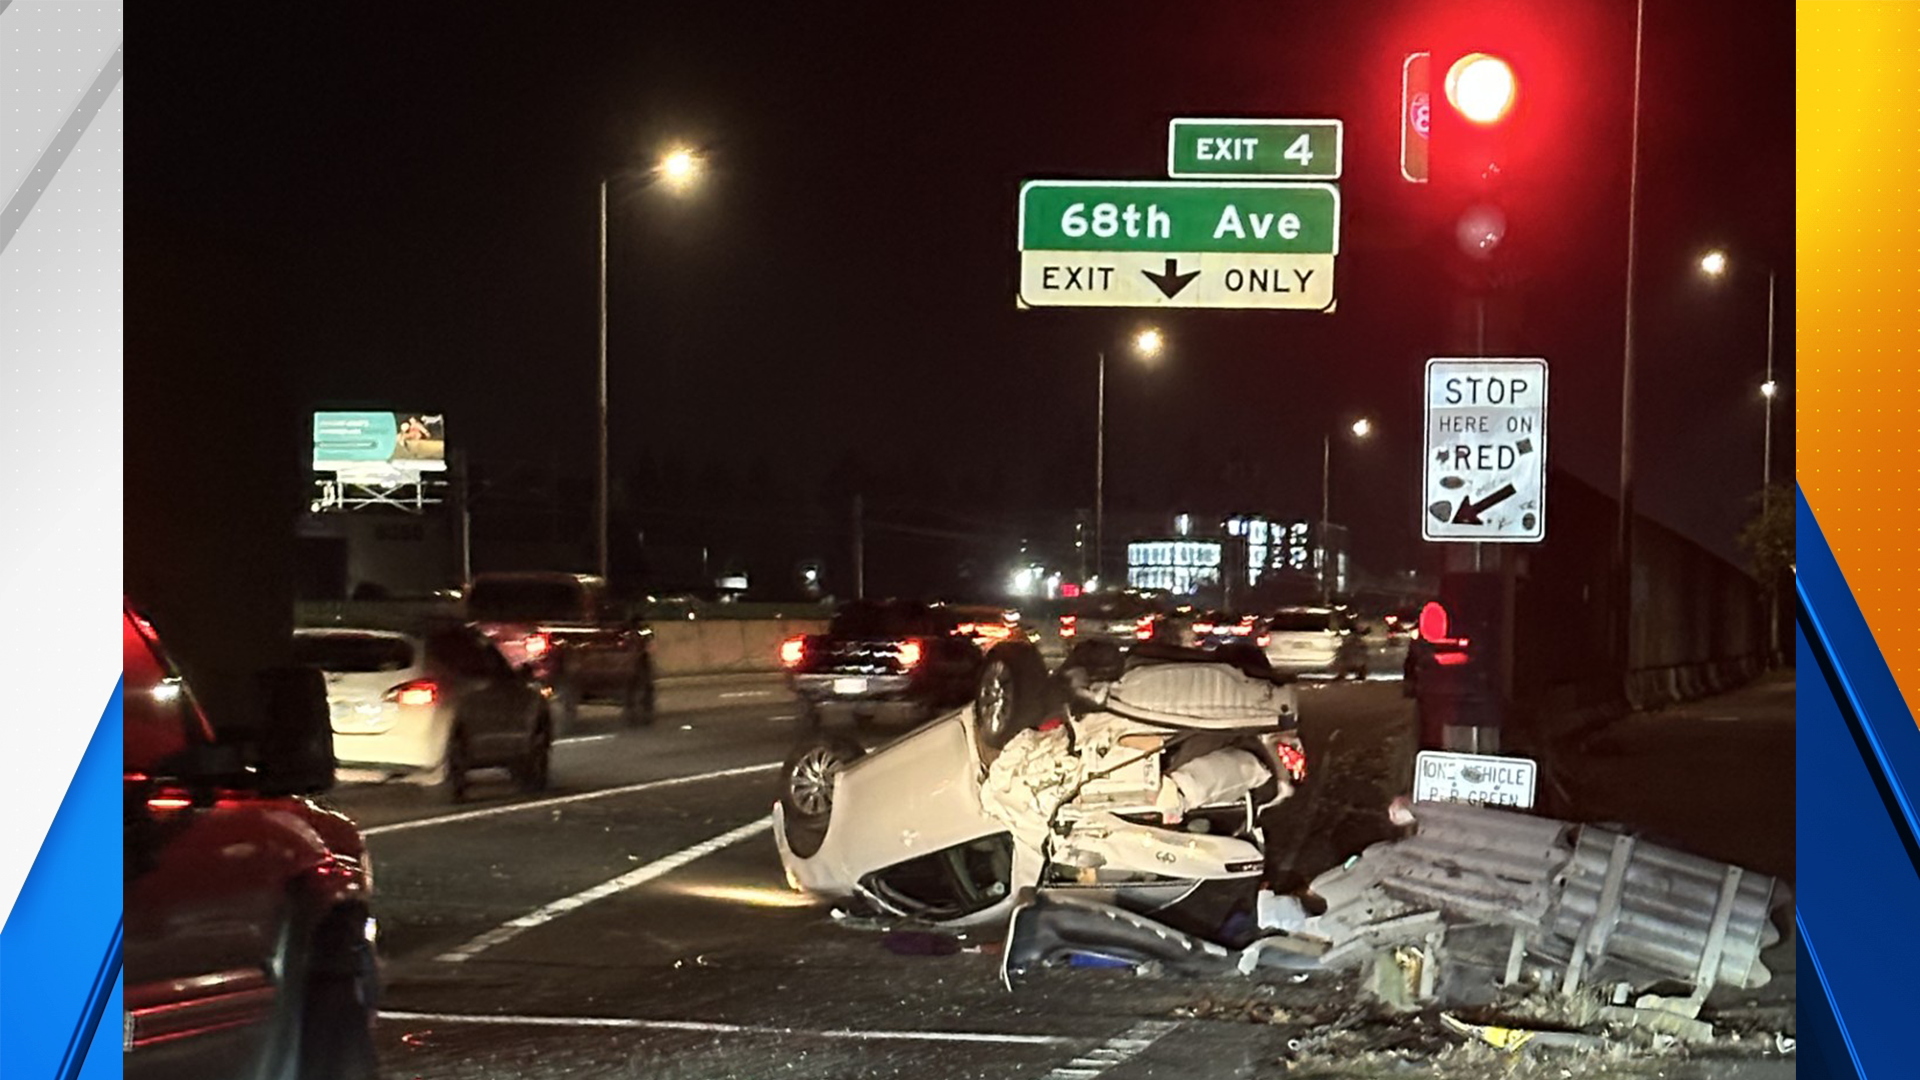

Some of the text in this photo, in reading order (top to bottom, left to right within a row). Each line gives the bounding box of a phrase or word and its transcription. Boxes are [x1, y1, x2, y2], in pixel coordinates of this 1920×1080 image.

[1196, 133, 1314, 166] EXIT 4
[1061, 202, 1301, 239] 68th Ave
[1042, 266, 1314, 293] EXIT ONLY
[1445, 377, 1528, 405] STOP
[1439, 415, 1533, 433] HERE ON
[1454, 444, 1515, 471] RED
[1429, 787, 1460, 803] PR
